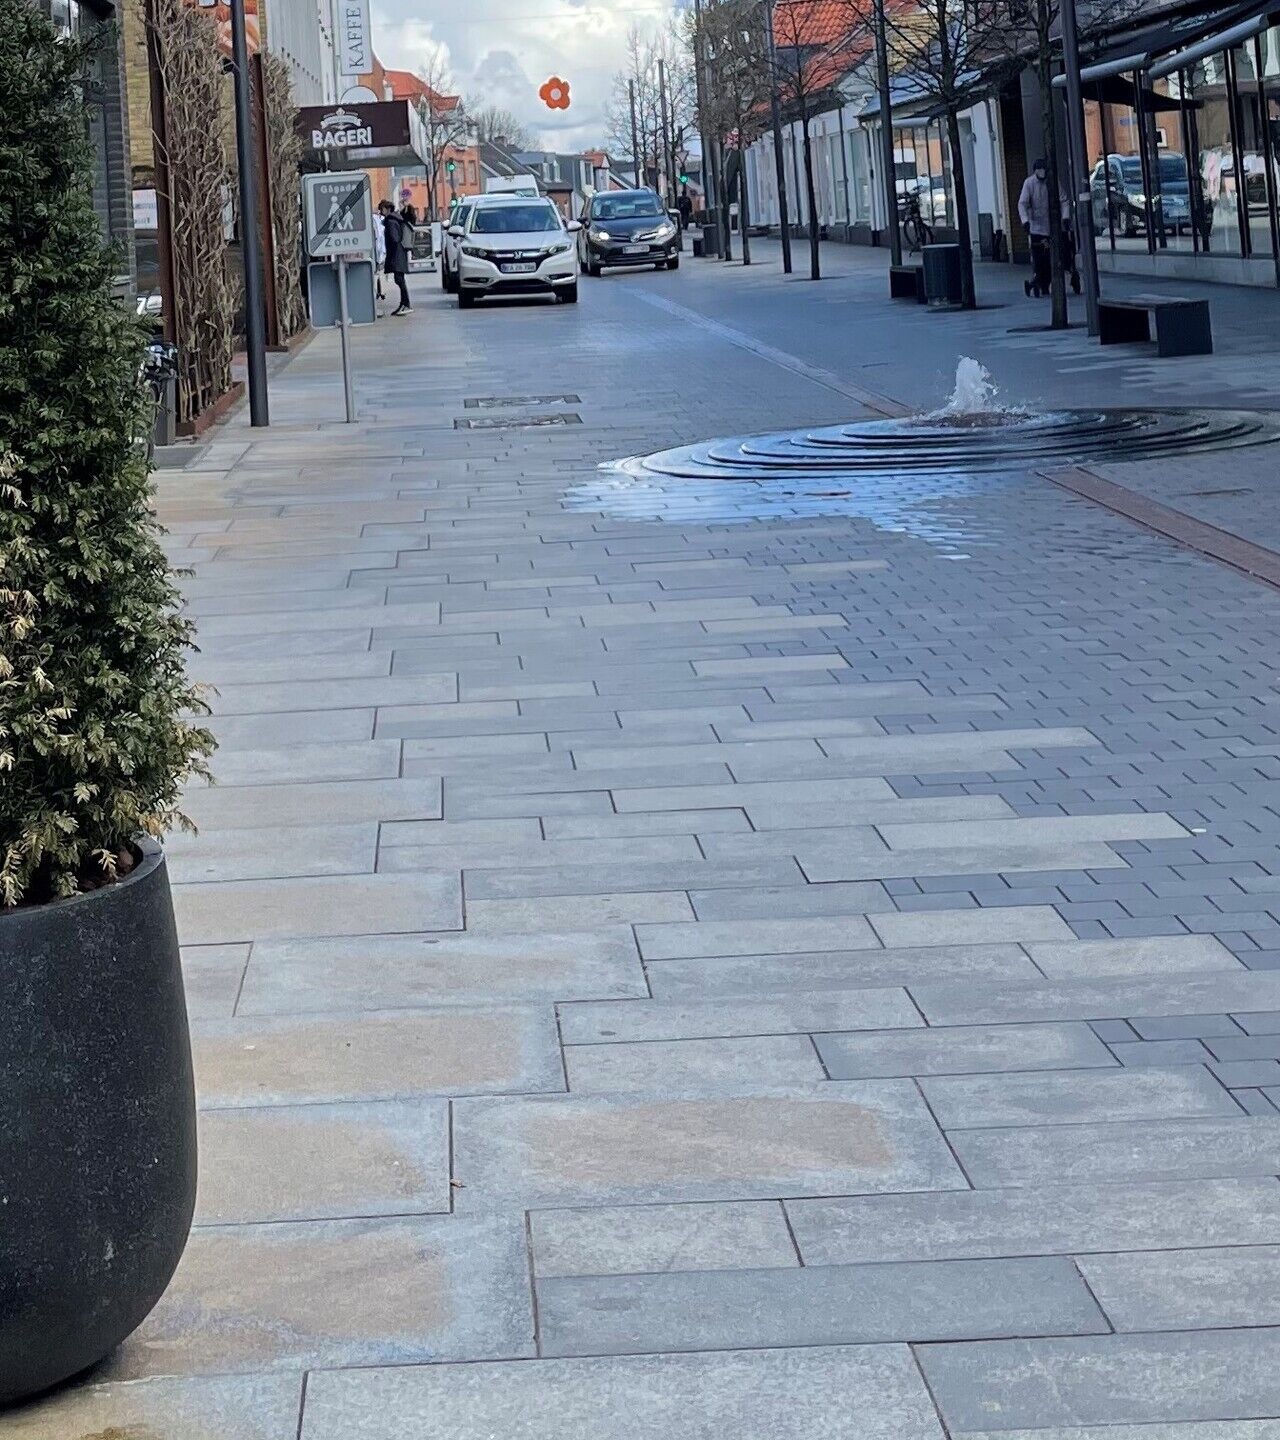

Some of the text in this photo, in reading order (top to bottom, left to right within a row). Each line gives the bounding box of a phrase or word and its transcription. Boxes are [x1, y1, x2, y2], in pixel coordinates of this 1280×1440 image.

[346, 7, 365, 68] KAFFE
[312, 126, 373, 148] BAGERI
[324, 236, 359, 248] Zone
